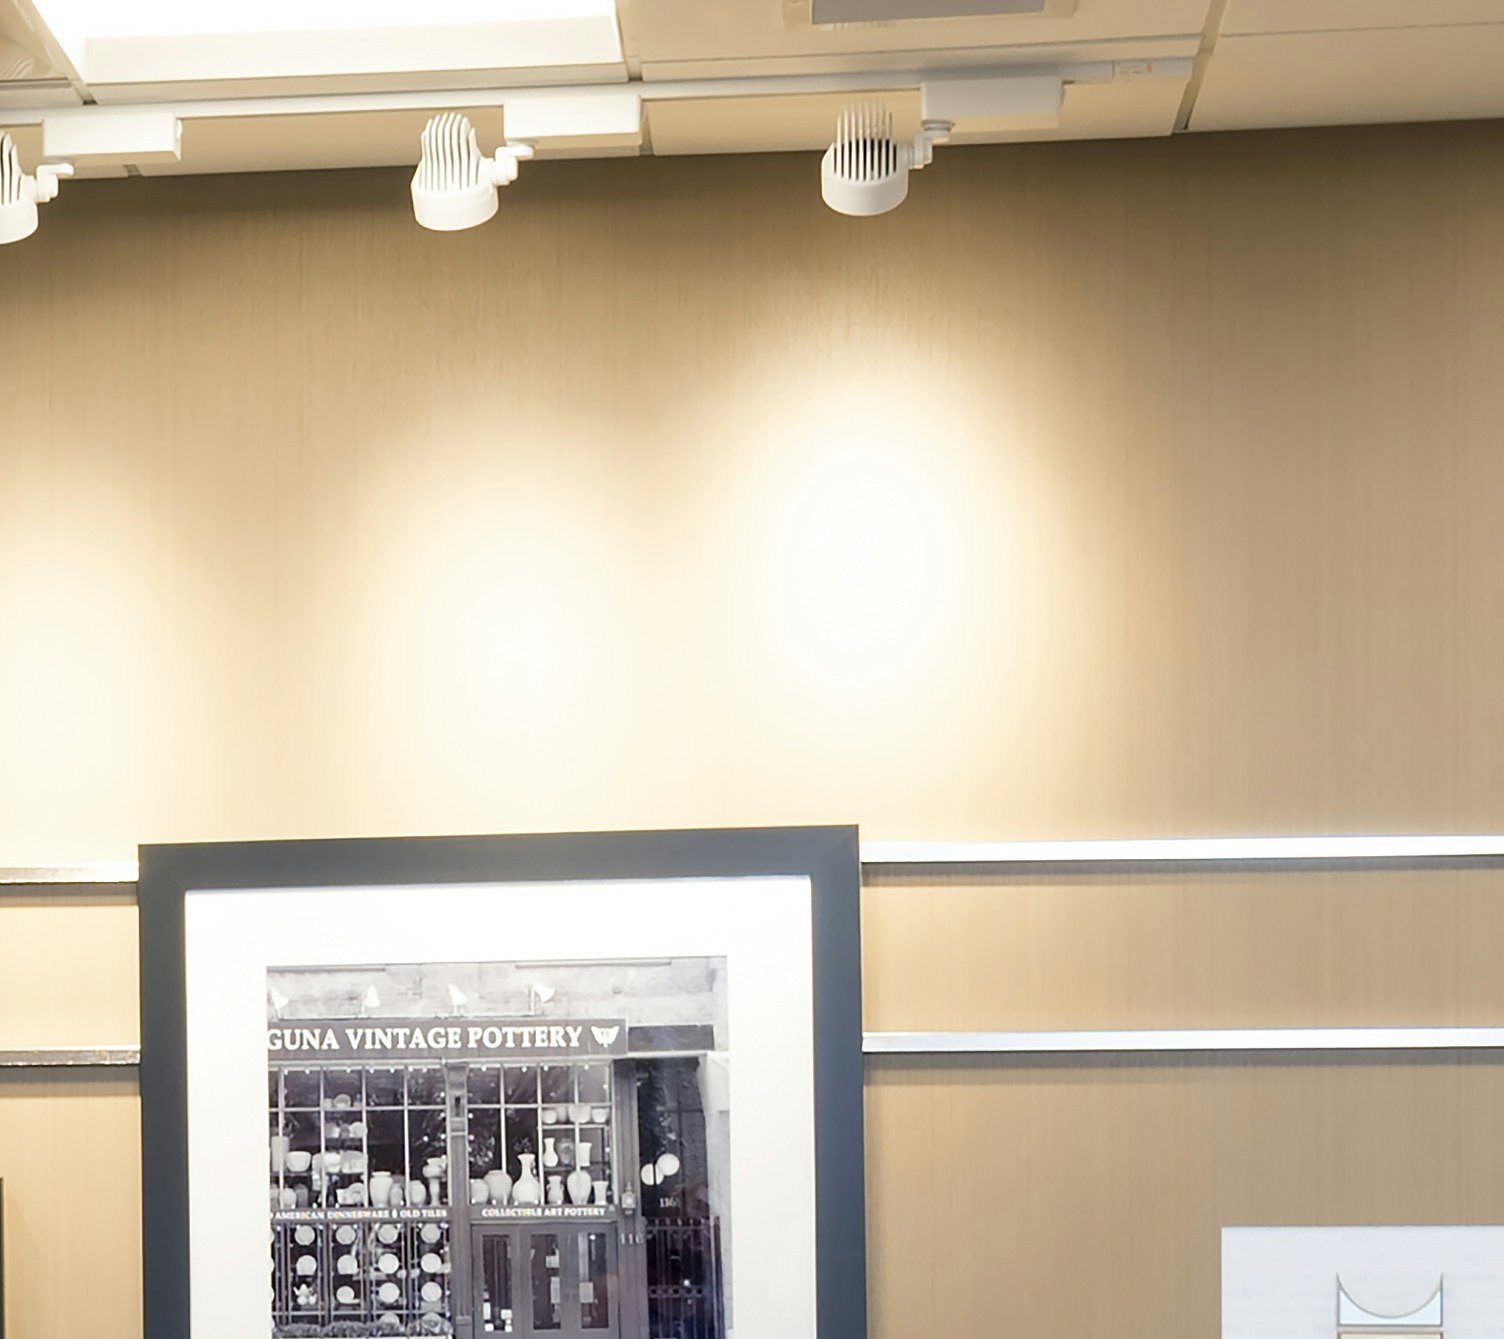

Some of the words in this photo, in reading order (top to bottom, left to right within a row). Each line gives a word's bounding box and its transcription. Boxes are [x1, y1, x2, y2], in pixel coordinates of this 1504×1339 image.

[345, 1026, 463, 1050] VINTAGE
[466, 1025, 583, 1049] POTTERY
[400, 1208, 421, 1218] OLD
[543, 1207, 563, 1217] ART
[564, 1206, 606, 1217] POTTERY
